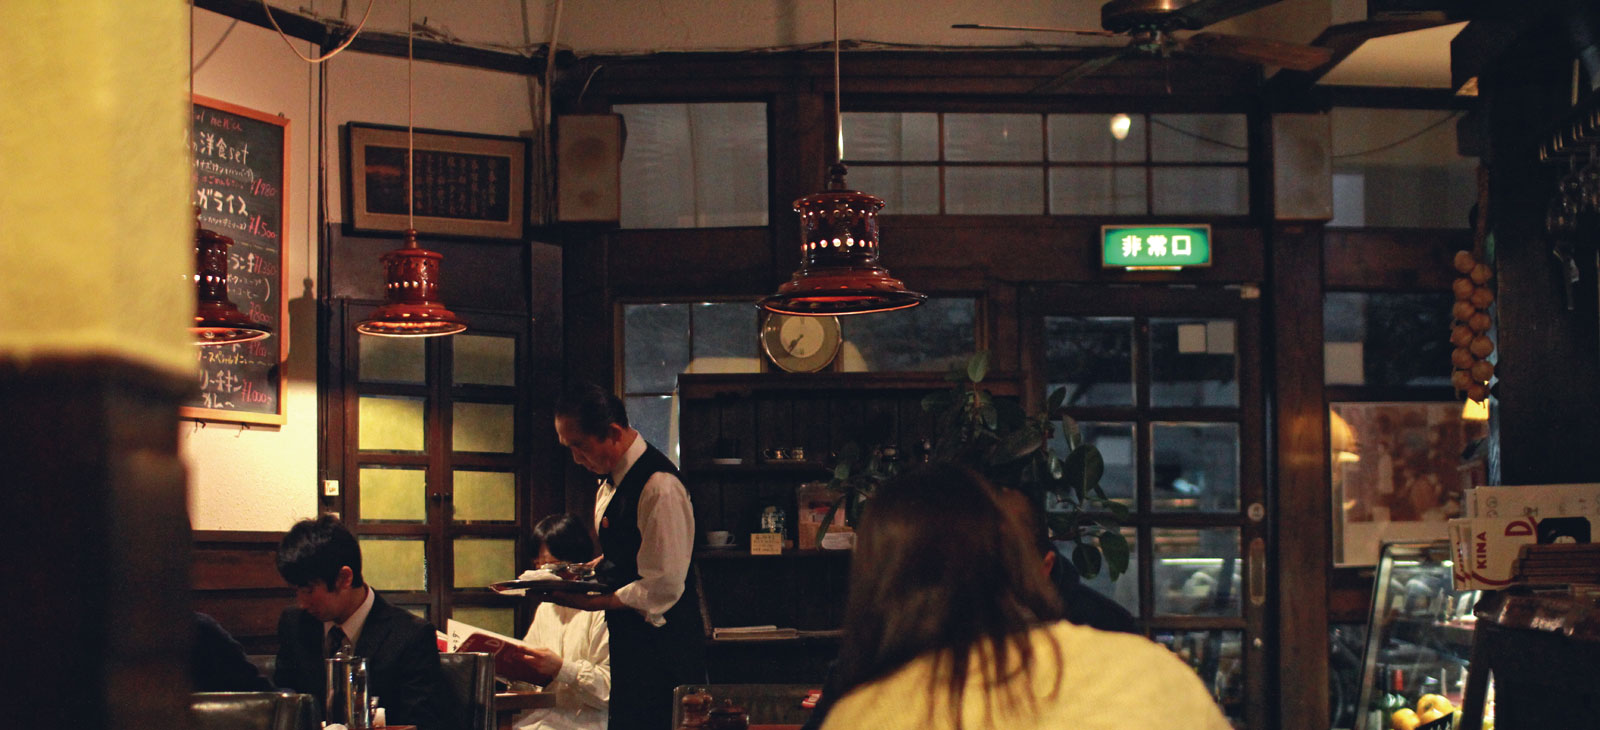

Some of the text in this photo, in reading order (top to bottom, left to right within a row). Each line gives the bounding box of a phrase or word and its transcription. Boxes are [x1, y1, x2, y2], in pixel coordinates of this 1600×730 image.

[192, 187, 249, 217] ガライス
[1121, 235, 1192, 257] 非常口
[1476, 531, 1488, 570] KINA
